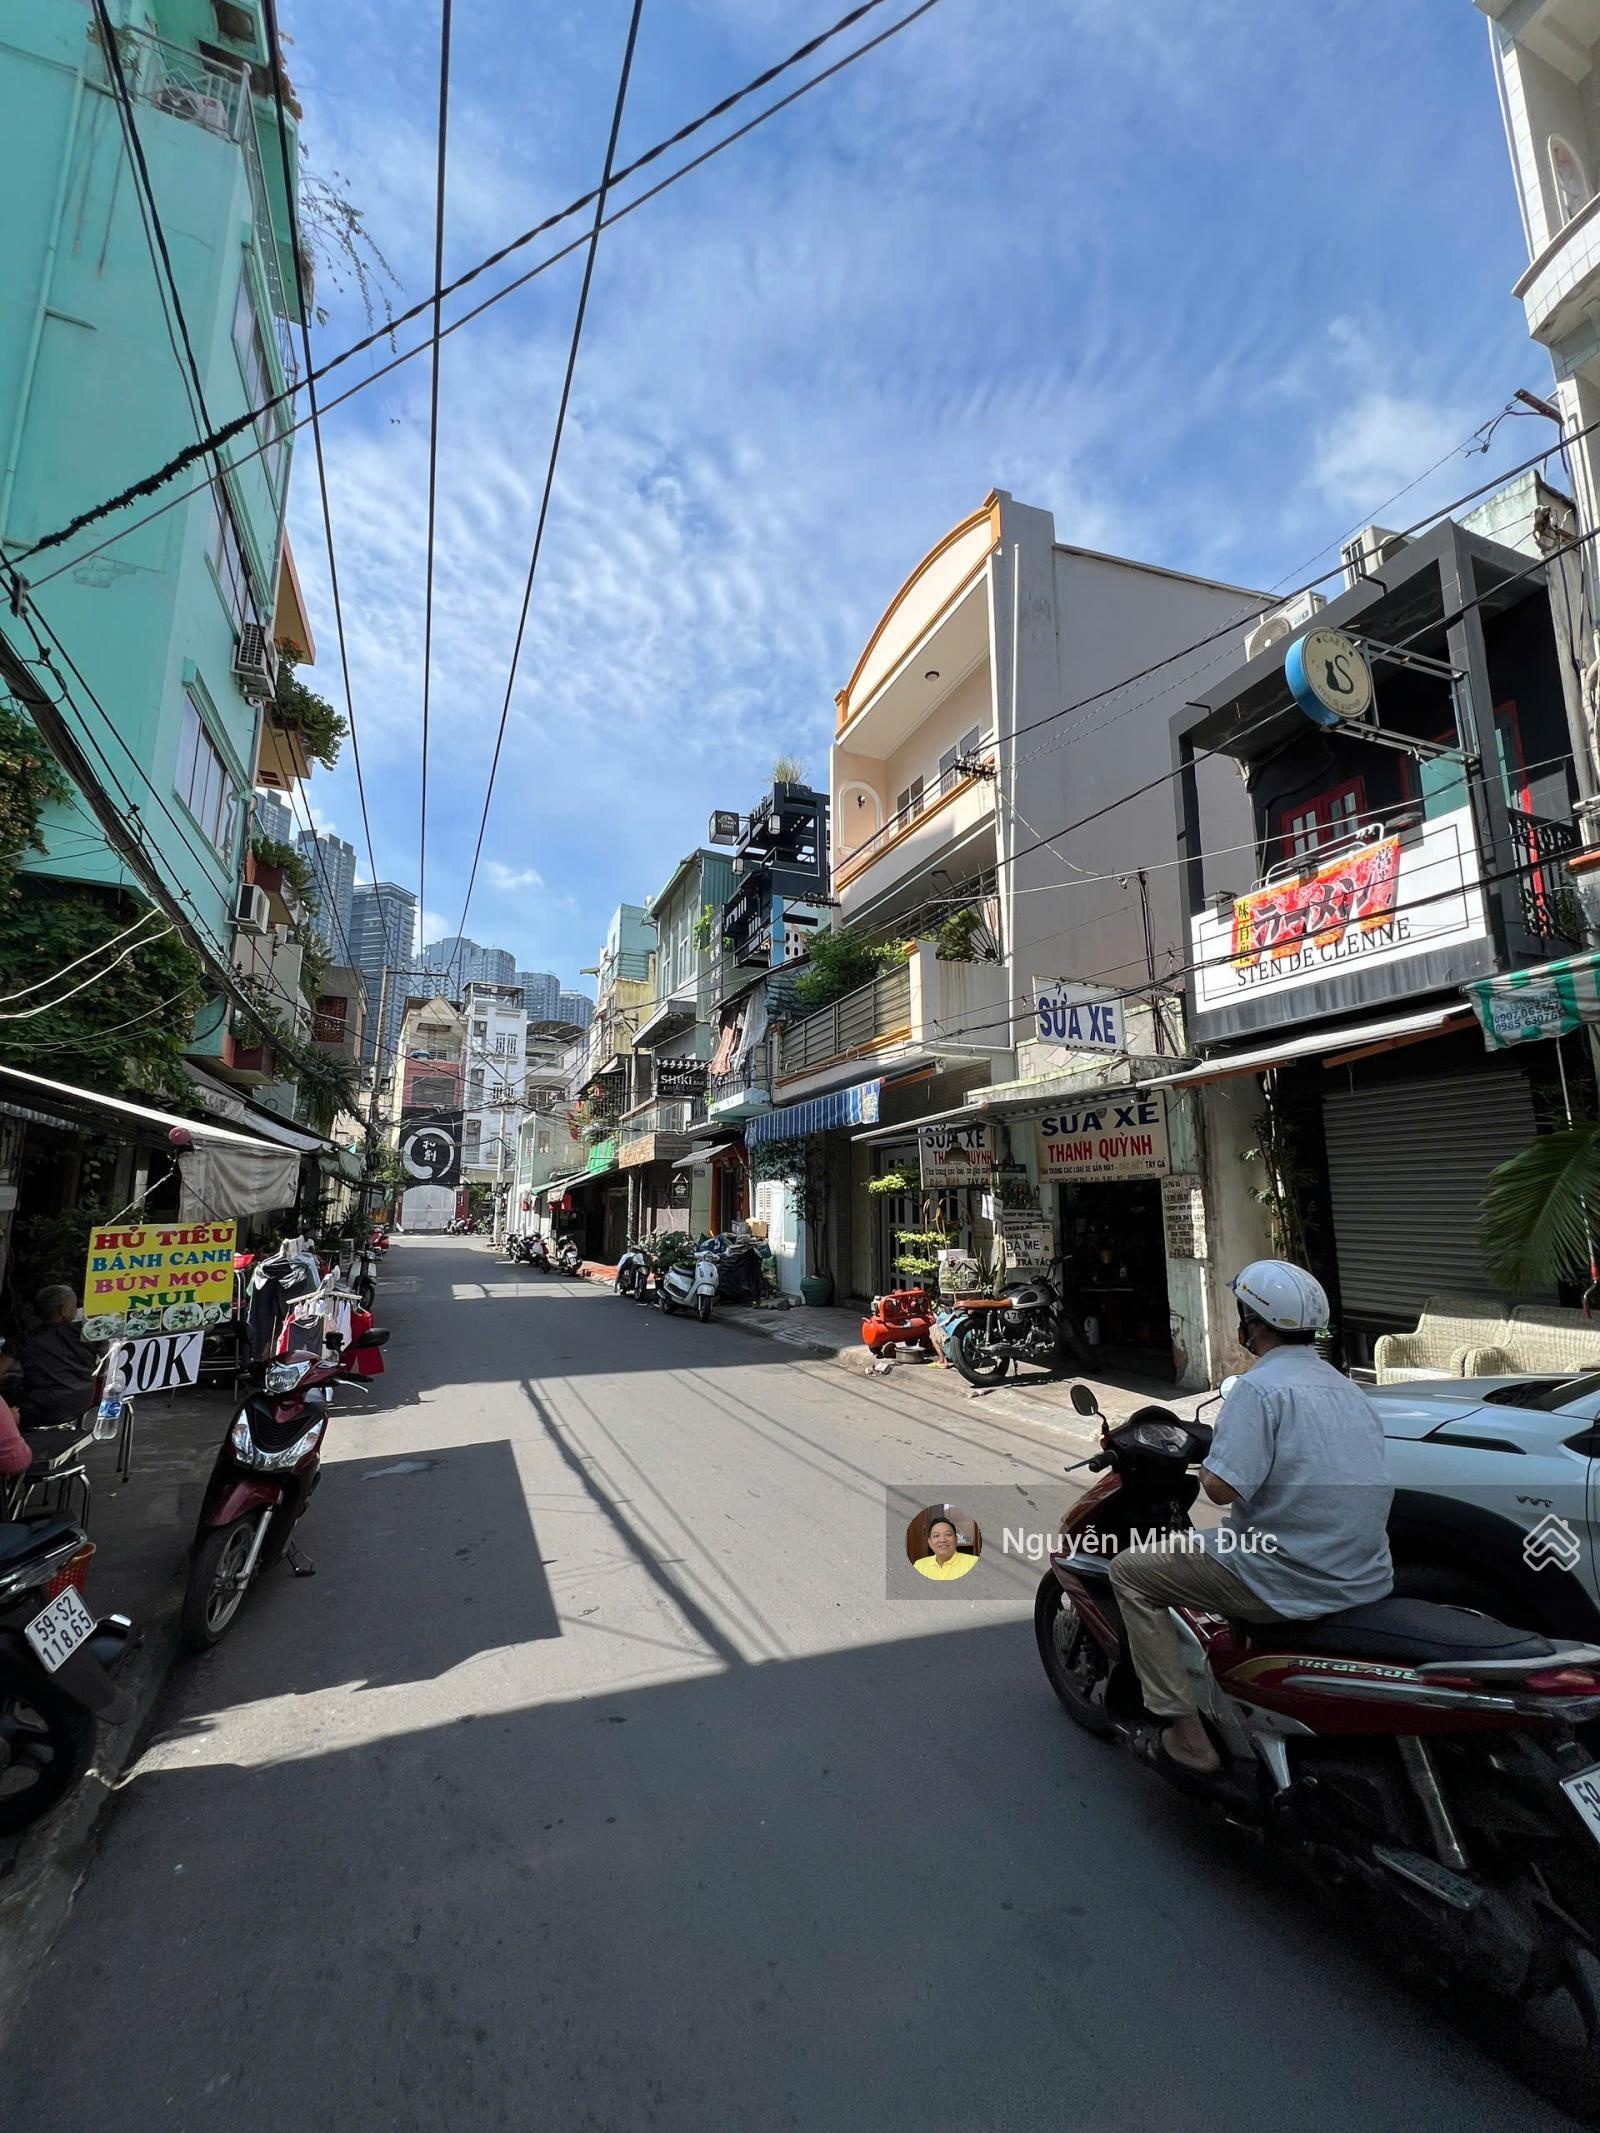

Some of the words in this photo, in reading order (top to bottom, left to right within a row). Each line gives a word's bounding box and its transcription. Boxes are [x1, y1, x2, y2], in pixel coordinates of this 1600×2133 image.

[1289, 946, 1315, 972] DE
[1320, 917, 1411, 962] CLENNE
[1039, 983, 1083, 1040] SỬA
[1088, 1003, 1116, 1044] XE
[660, 1074, 693, 1085] SHIKI
[1114, 1102, 1160, 1128] XE
[966, 1128, 985, 1148] XE
[1048, 1141, 1092, 1162] THANH
[1099, 1132, 1153, 1161] QUỲNH
[94, 1225, 147, 1250] HỦ
[156, 1222, 235, 1246] TIẾU
[1024, 1240, 1041, 1250] ME
[92, 1252, 163, 1272] BÁNH
[169, 1249, 232, 1265] CANH
[94, 1273, 160, 1294] BÚN
[168, 1269, 228, 1287] MỌC
[128, 1290, 196, 1309] NUI
[119, 1333, 199, 1392] 30K
[34, 1595, 77, 1642] 59-S2
[42, 1609, 92, 1666] 118.65
